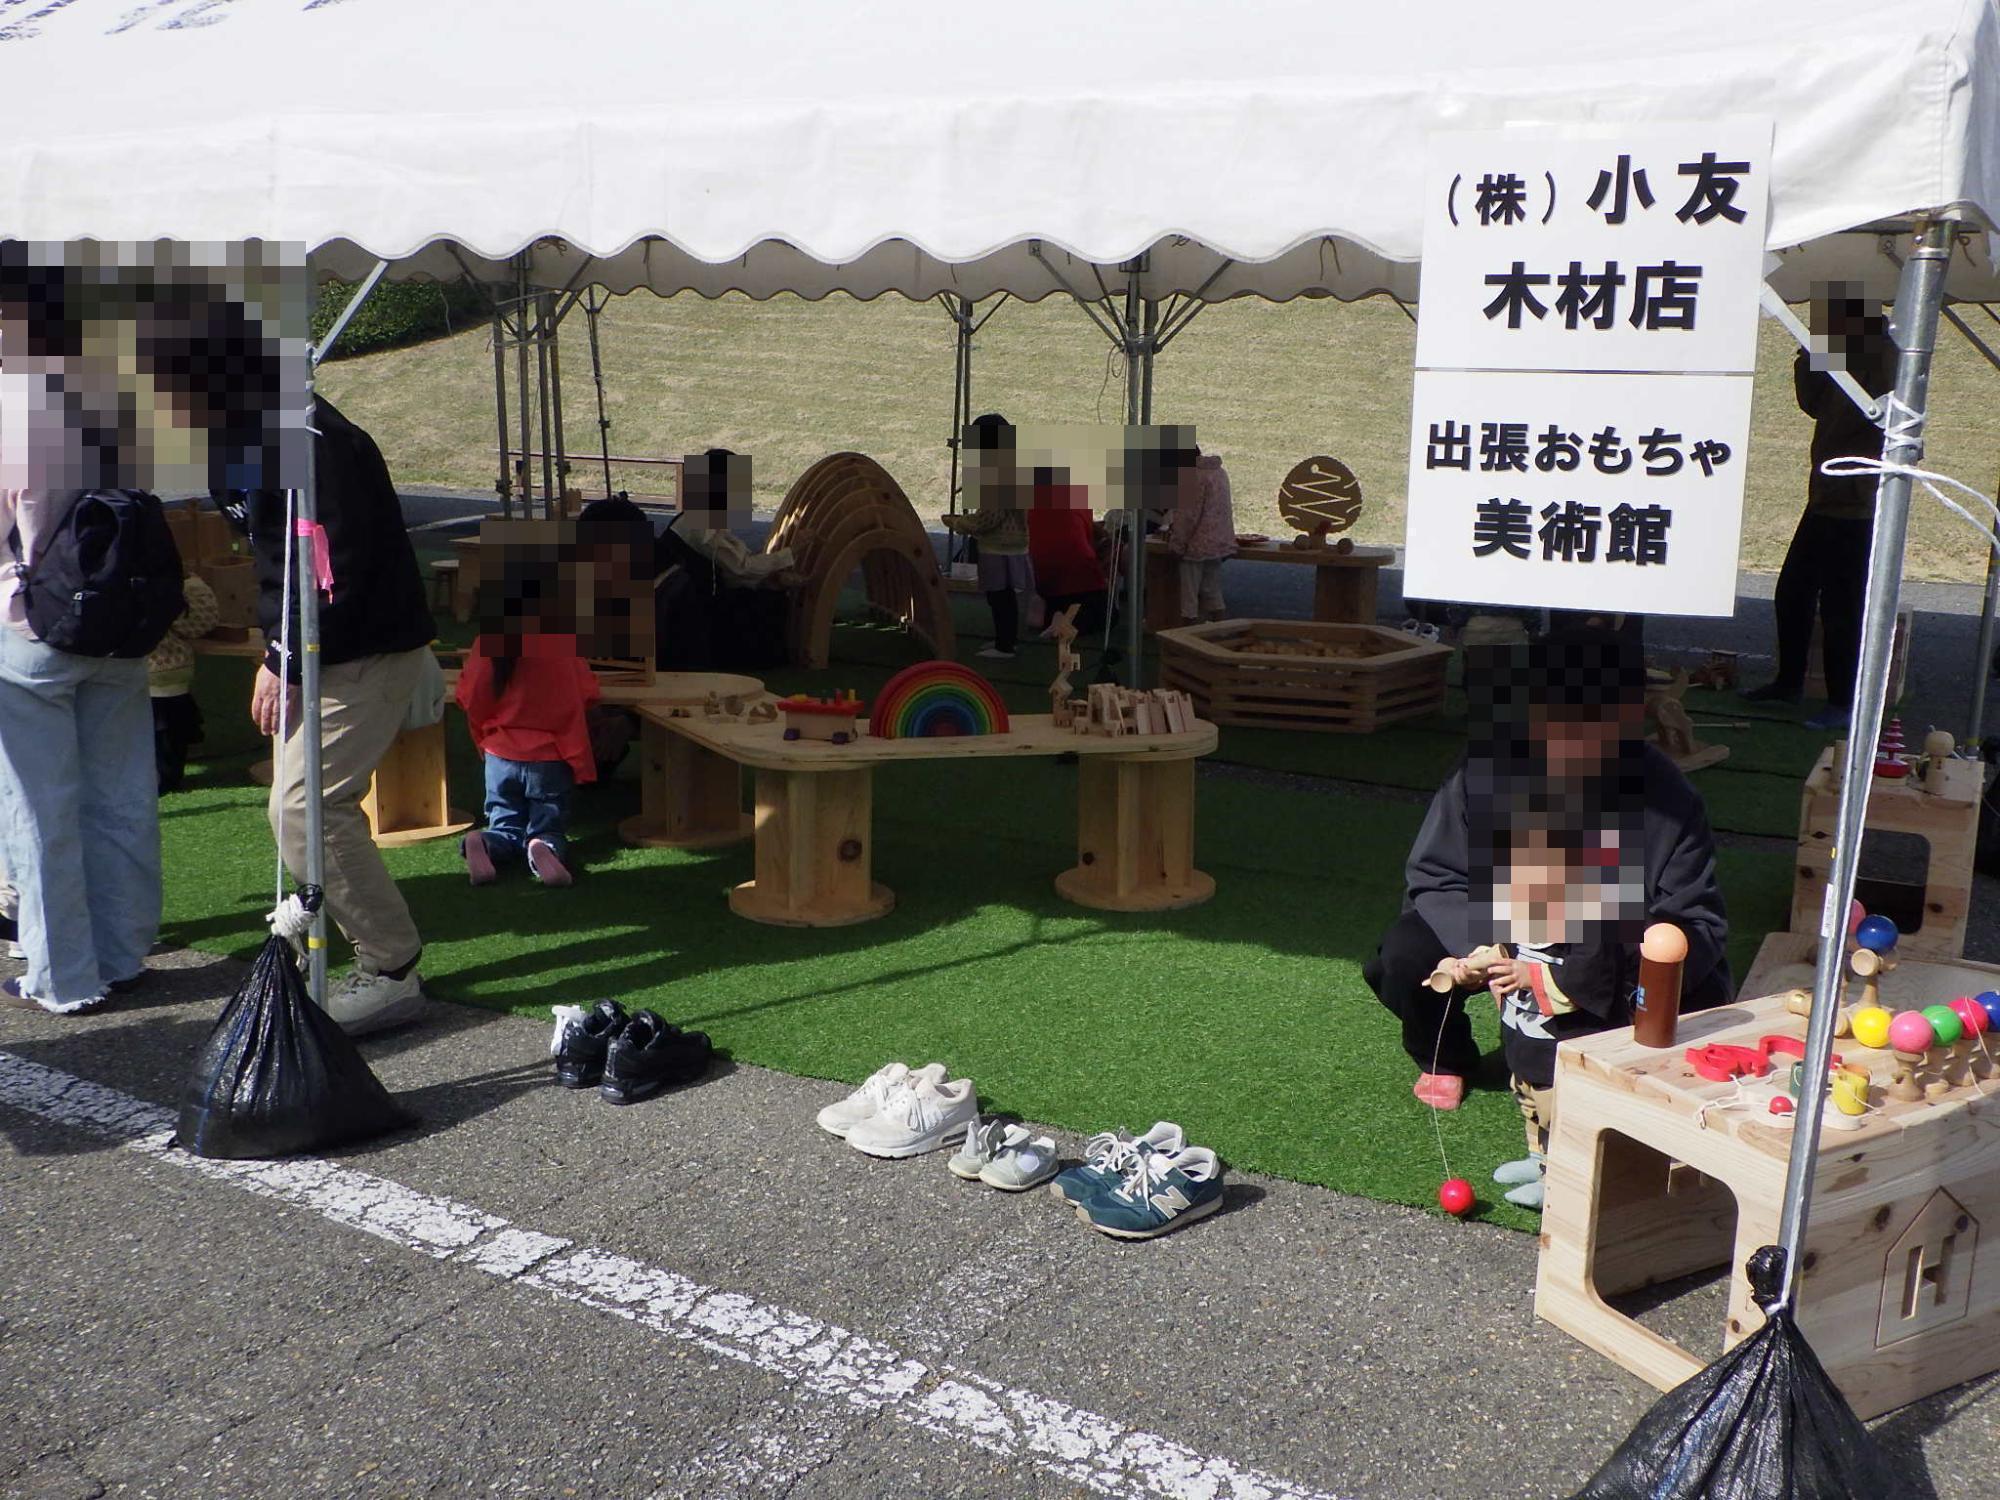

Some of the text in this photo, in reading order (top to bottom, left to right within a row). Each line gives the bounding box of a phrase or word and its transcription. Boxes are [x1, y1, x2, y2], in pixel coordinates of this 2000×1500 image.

[1448, 152, 1751, 227] （株）小友
[1483, 261, 1702, 331] 木材店
[1426, 420, 1731, 478] 出張おもちゃ
[1473, 498, 1672, 566] 美術館
